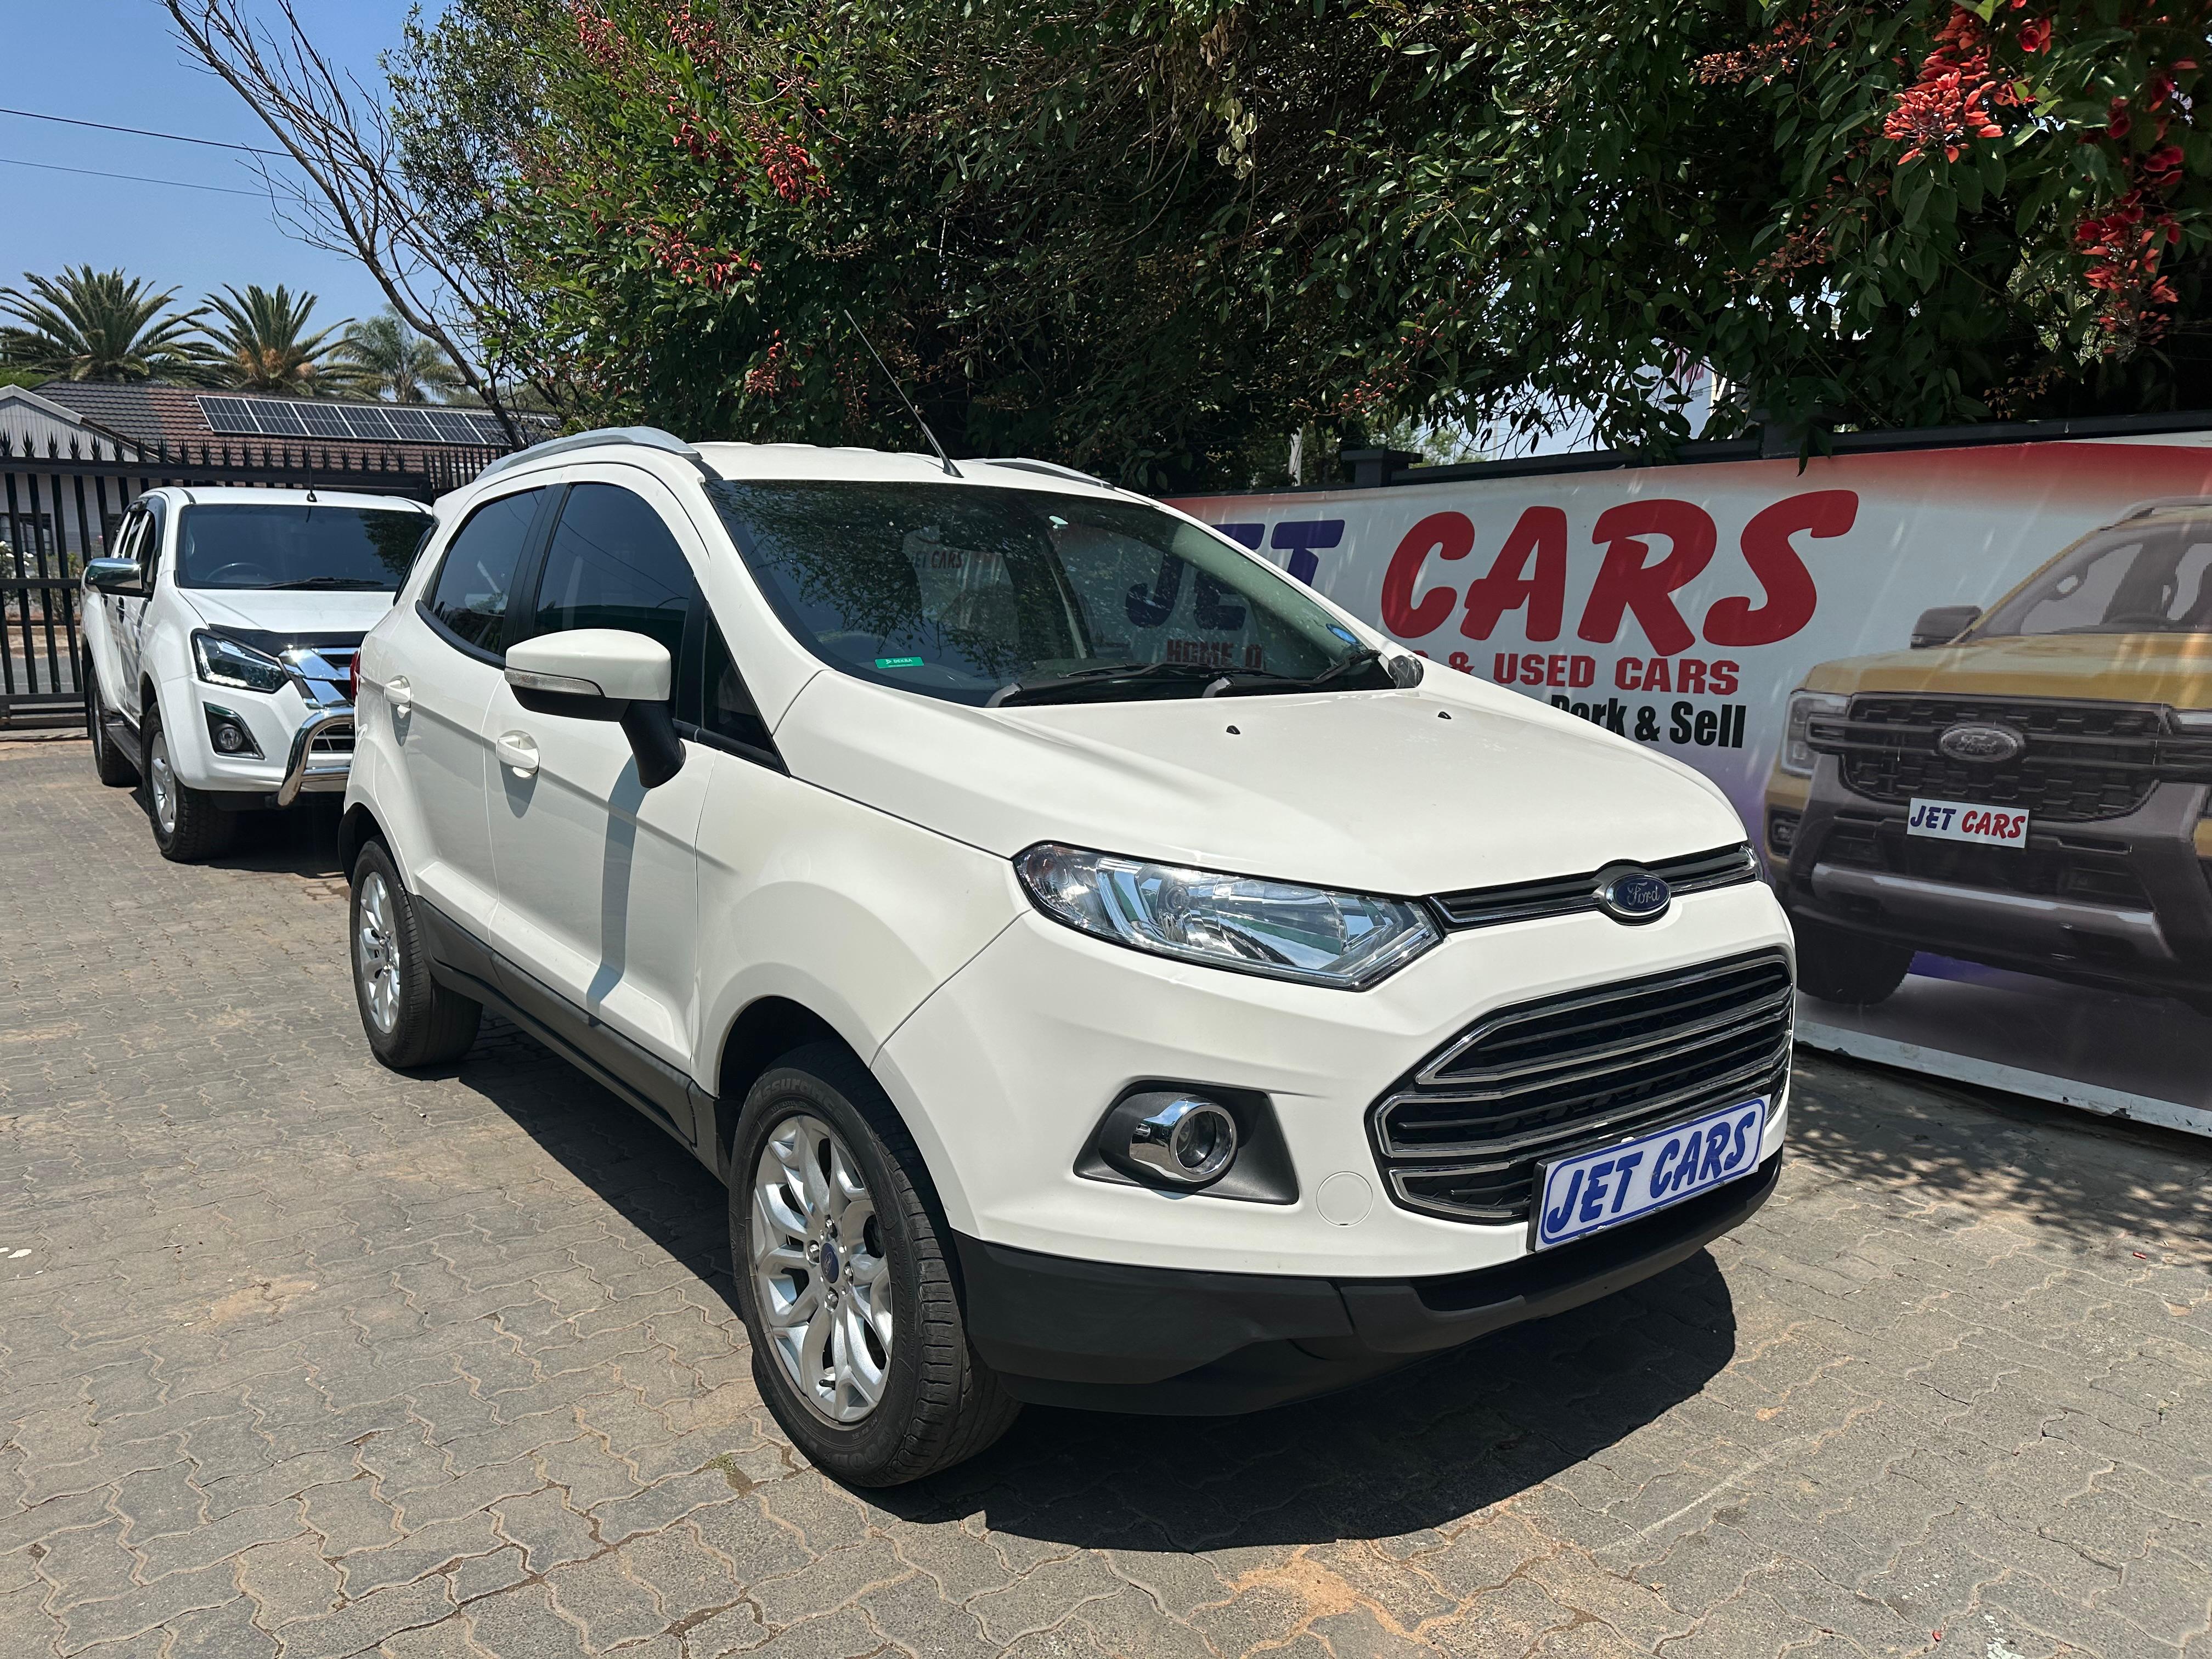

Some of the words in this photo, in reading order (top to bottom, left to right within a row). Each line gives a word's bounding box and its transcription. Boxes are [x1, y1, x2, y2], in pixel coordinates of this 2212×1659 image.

[1381, 490, 1858, 657] CARS
[1167, 639, 1234, 666] HOME
[1493, 652, 1595, 689] USED
[1614, 656, 1740, 696] CARS
[1634, 706, 1661, 742] &
[1669, 701, 1747, 748] Sell
[1910, 805, 1957, 831] JET
[1961, 810, 2026, 839] CARS
[1627, 882, 1660, 906] Ford
[1547, 1150, 1644, 1234] JET
[1650, 1111, 1756, 1199] CARS
